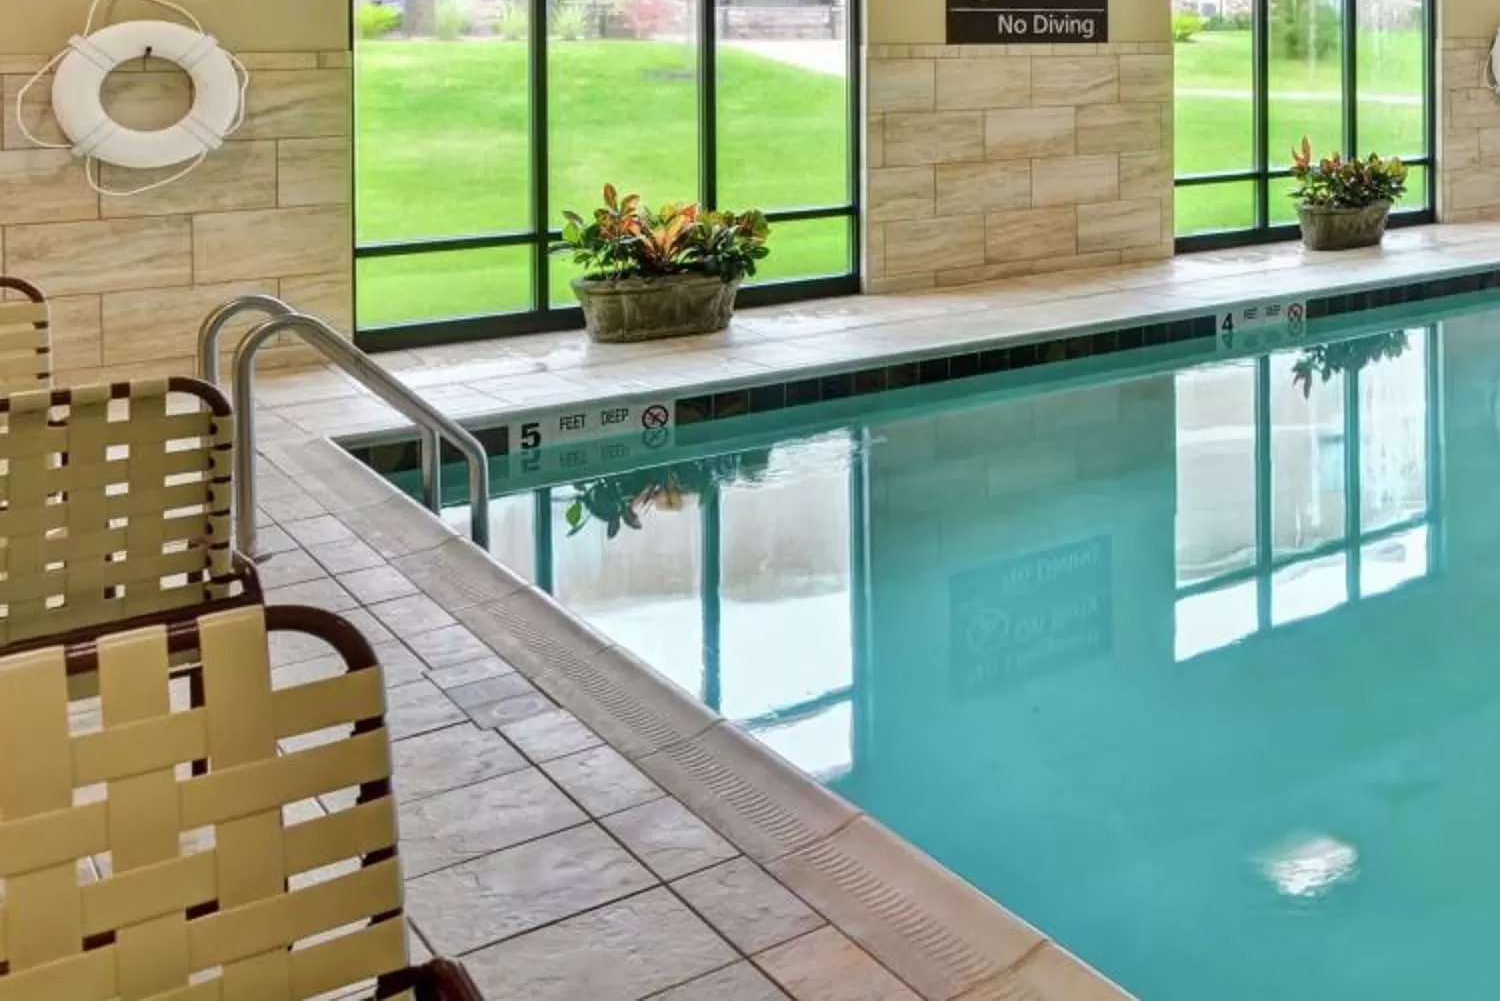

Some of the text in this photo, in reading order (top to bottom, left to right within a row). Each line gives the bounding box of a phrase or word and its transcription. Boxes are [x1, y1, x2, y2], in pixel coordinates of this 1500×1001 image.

[998, 14, 1095, 38] No Diving
[1221, 312, 1234, 330] 4
[520, 408, 629, 449] 5 FEET DEEP
